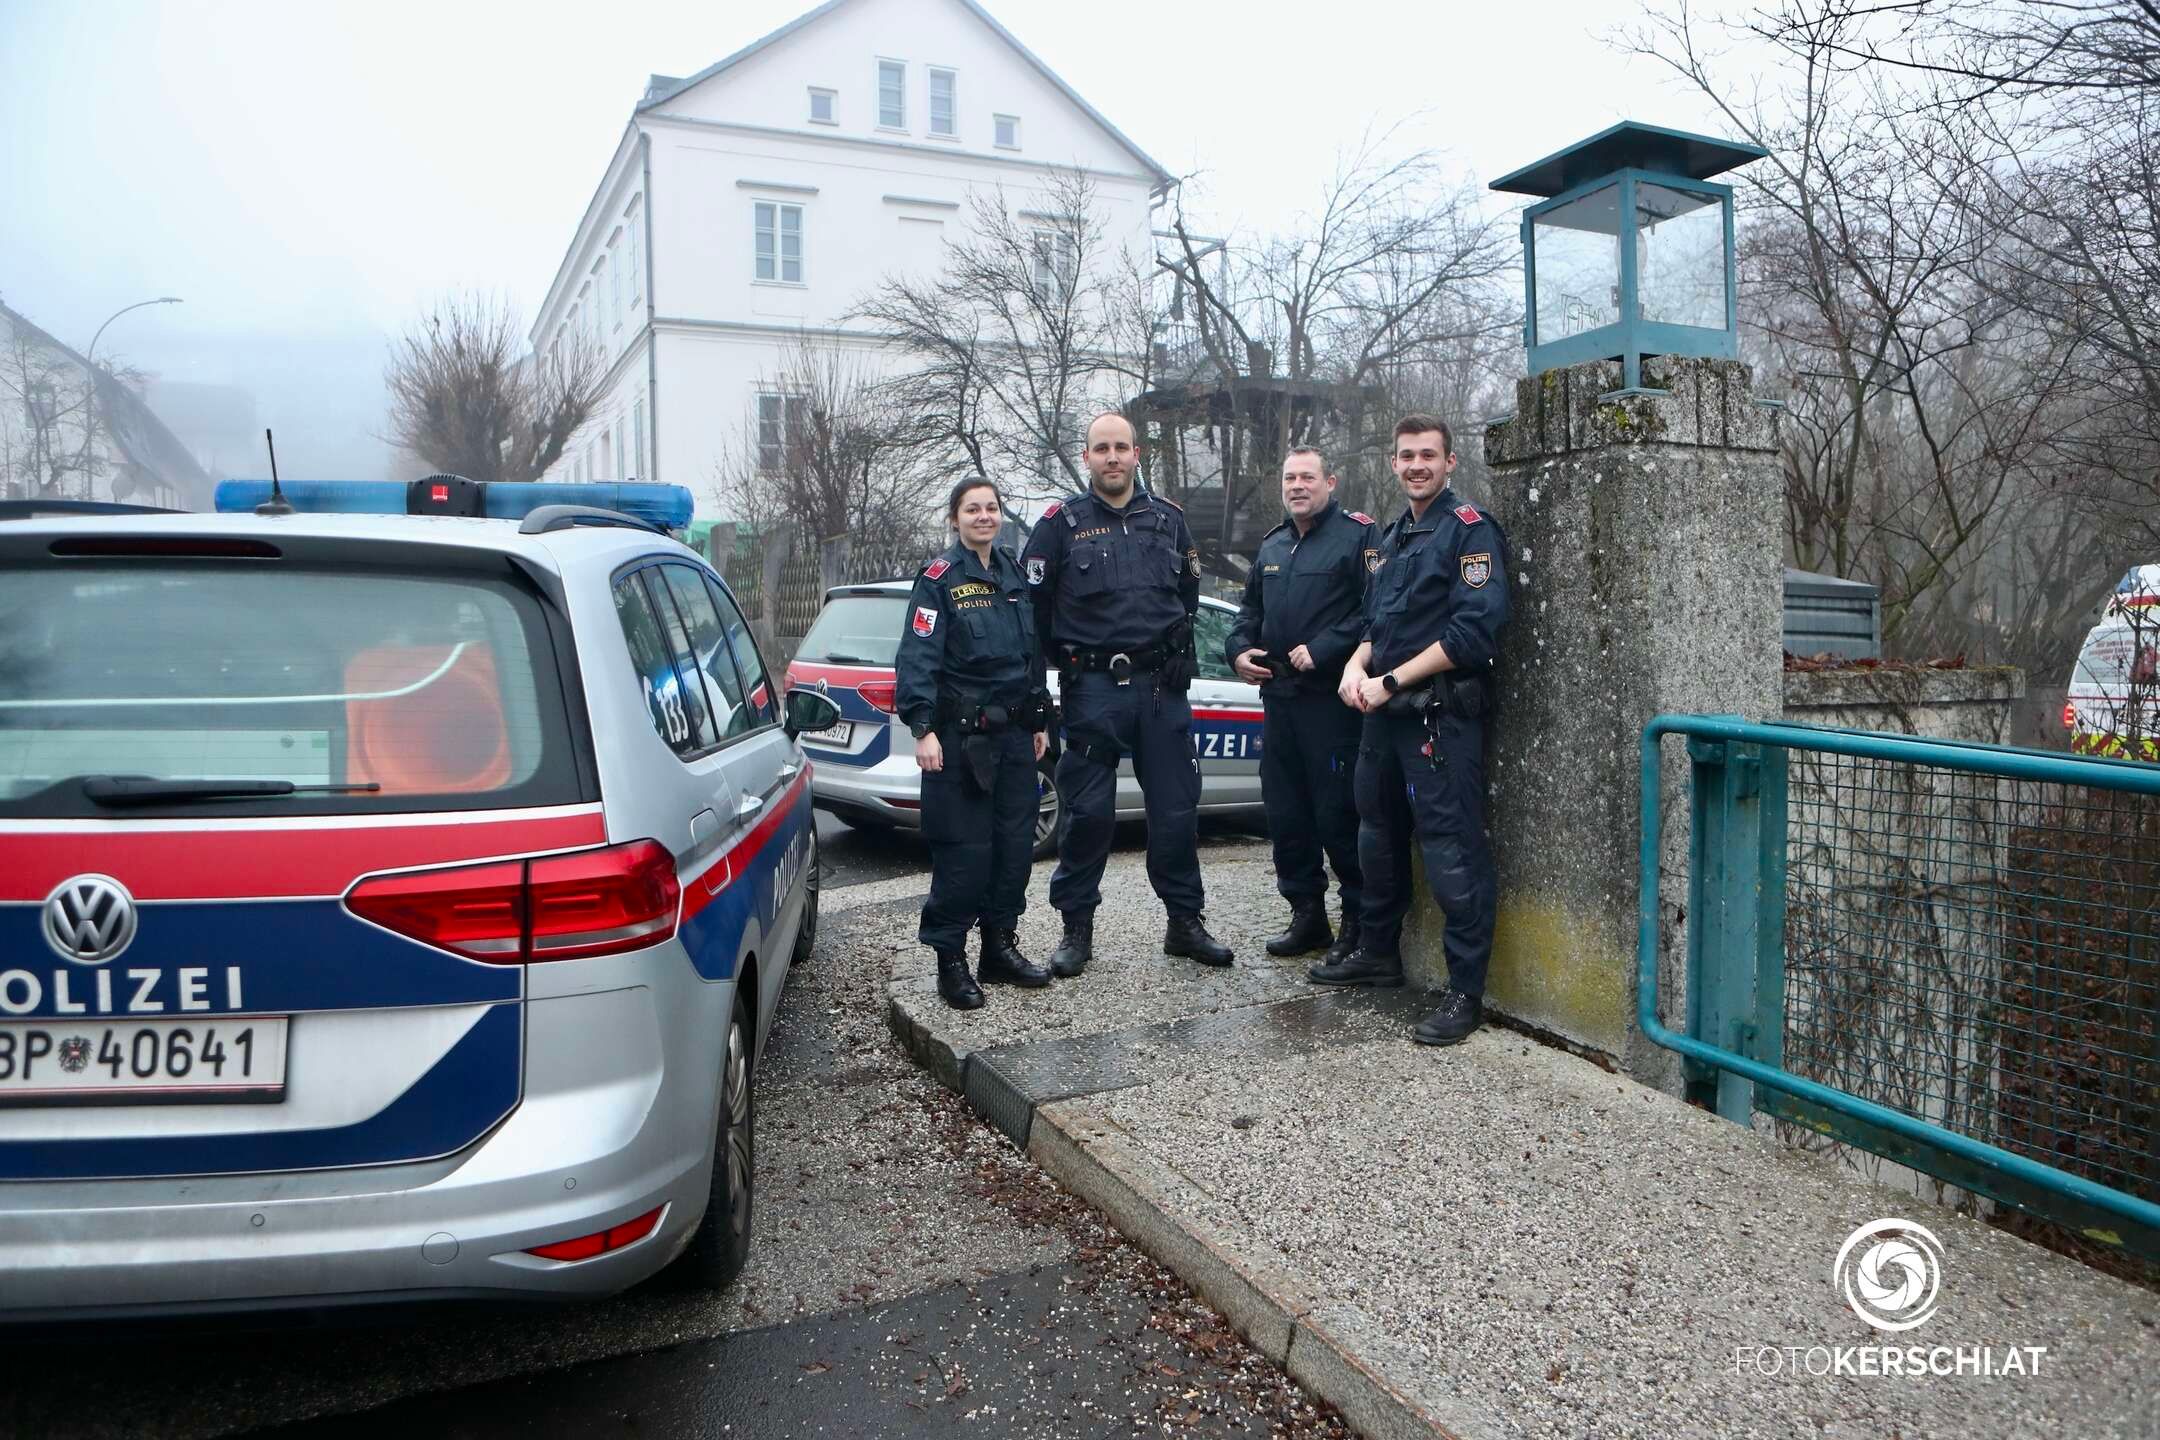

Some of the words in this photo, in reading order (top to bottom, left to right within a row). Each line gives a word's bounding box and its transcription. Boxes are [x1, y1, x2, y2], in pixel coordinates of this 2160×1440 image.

[1074, 527, 1110, 541] POLIZEI
[1463, 556, 1488, 564] POLIZEI
[958, 586, 990, 597] LENTOS
[957, 600, 992, 610] POLIZEI
[656, 687, 689, 743] 133
[773, 830, 799, 920] POLIZEI
[97, 1027, 254, 1079] 40641
